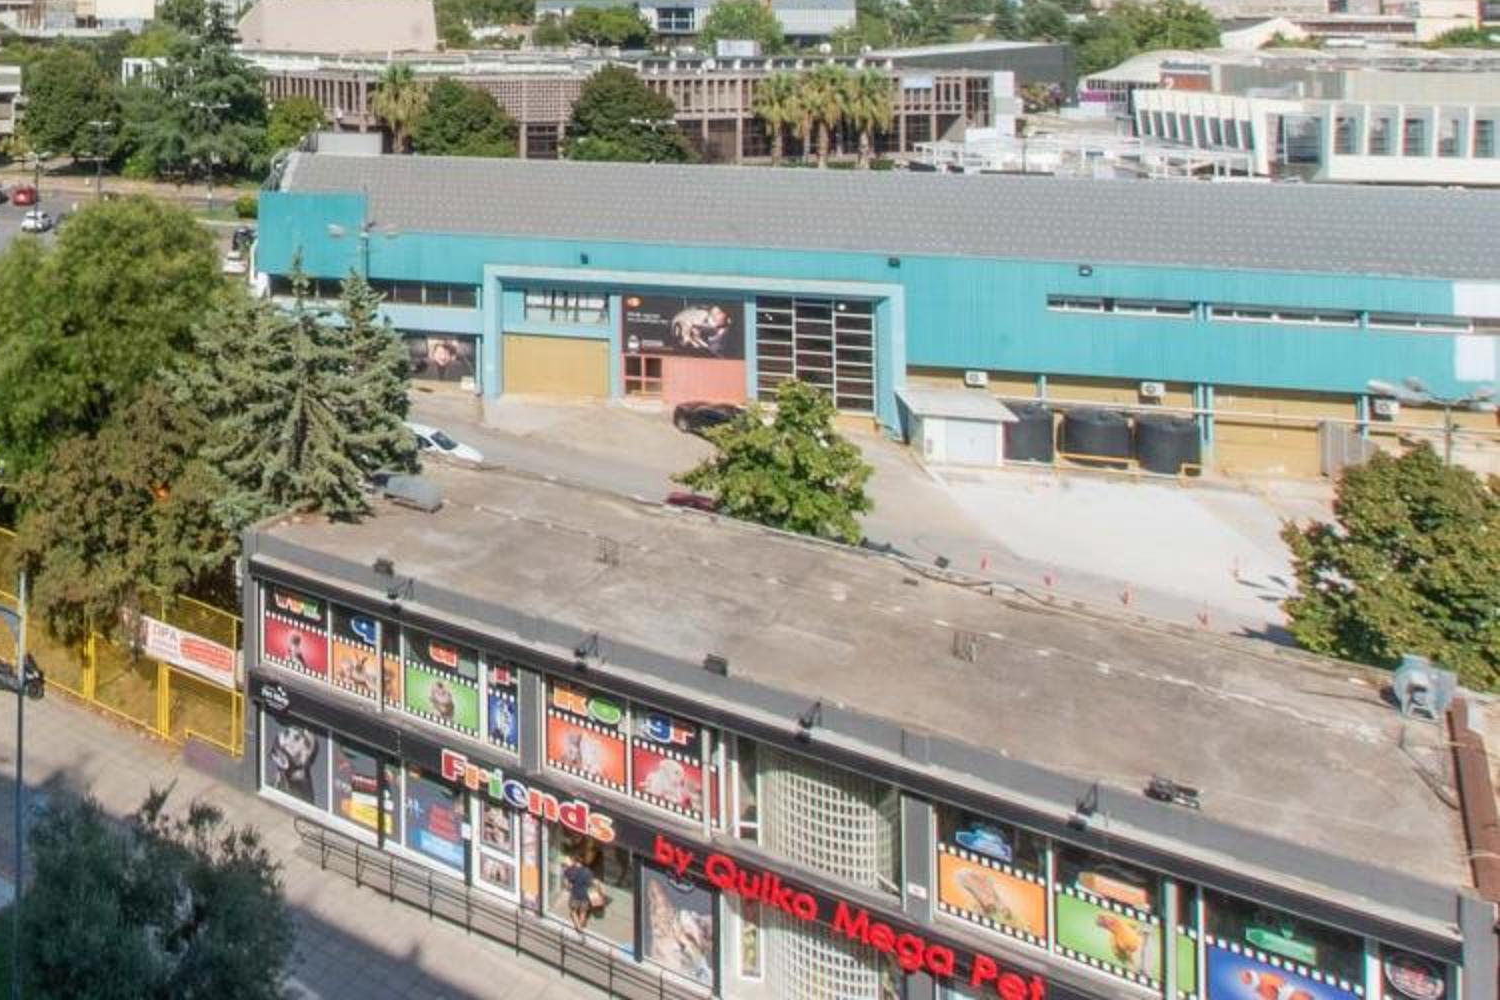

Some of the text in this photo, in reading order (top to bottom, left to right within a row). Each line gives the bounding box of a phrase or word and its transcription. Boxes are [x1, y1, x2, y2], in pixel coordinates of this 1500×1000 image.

[441, 749, 615, 842] Friends
[654, 834, 1046, 1000] by Quiko Mega Pet
